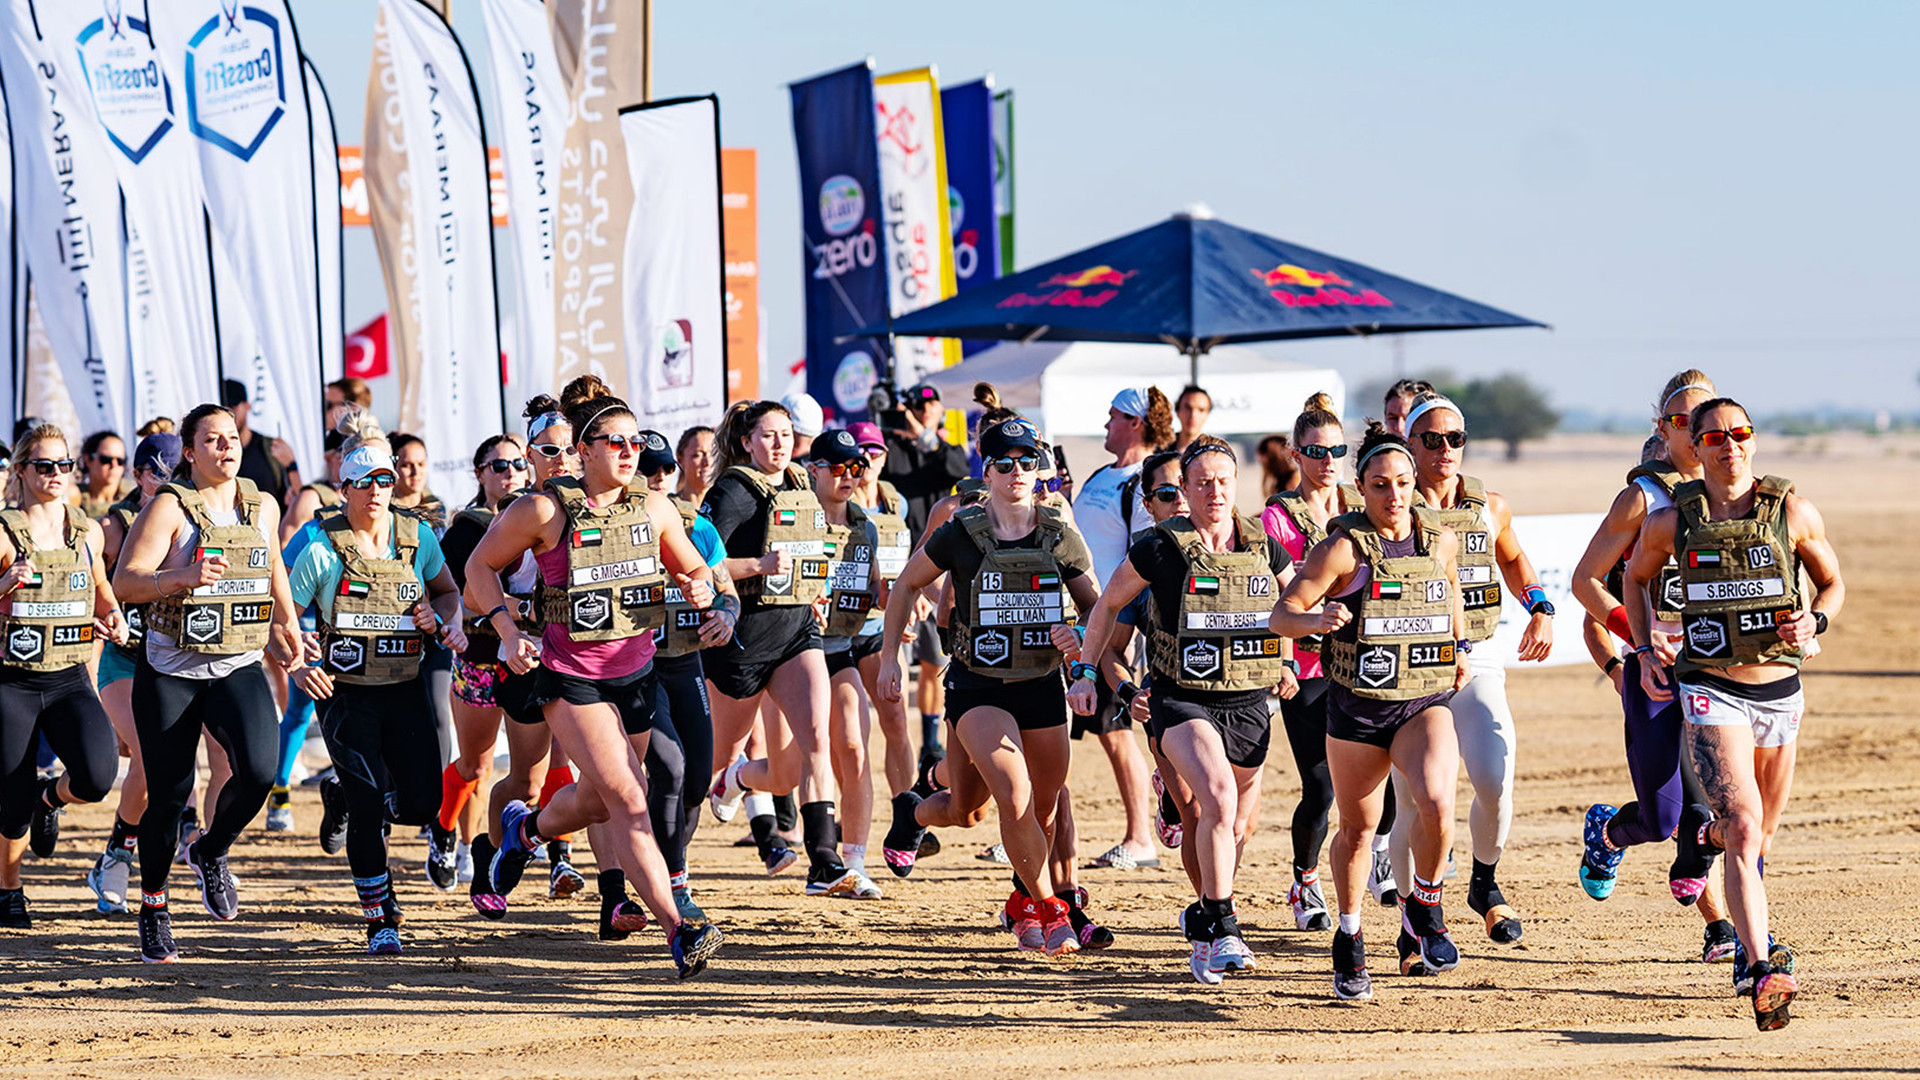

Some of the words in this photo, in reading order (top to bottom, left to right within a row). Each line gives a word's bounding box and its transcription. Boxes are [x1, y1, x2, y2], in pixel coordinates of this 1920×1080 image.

[813, 231, 877, 279] zero
[633, 524, 651, 543] 11
[1469, 534, 1486, 551] 37
[251, 550, 268, 567] 01
[854, 545, 870, 561] 05
[1751, 546, 1772, 566] 09
[590, 562, 640, 581] G.MIGALA
[802, 563, 819, 577] 5.11
[72, 572, 87, 588] 03
[210, 580, 256, 594] L.HORVATH
[984, 573, 1000, 589] 15
[1251, 577, 1269, 594] 02
[400, 583, 418, 601] 05
[623, 588, 651, 605] 5.11
[1428, 582, 1444, 600] 13
[1706, 581, 1765, 599] S.BRIGGS
[838, 596, 860, 609] 5.11
[233, 605, 259, 621] 5.11
[678, 612, 700, 626] 5.11
[997, 609, 1046, 623] HELLMAN
[1204, 615, 1233, 628] CENTRAL
[1233, 614, 1257, 627] BEASTS
[353, 615, 401, 630] C.PREVOST
[1382, 618, 1433, 633] K.JACKSON
[1740, 612, 1775, 631] 5.11
[54, 627, 80, 643] 5.11
[1023, 631, 1051, 646] 5.11
[377, 639, 405, 654] 5.11
[1233, 640, 1263, 656] 5.11
[1411, 646, 1440, 664] 5.11
[1688, 696, 1710, 716] 13
